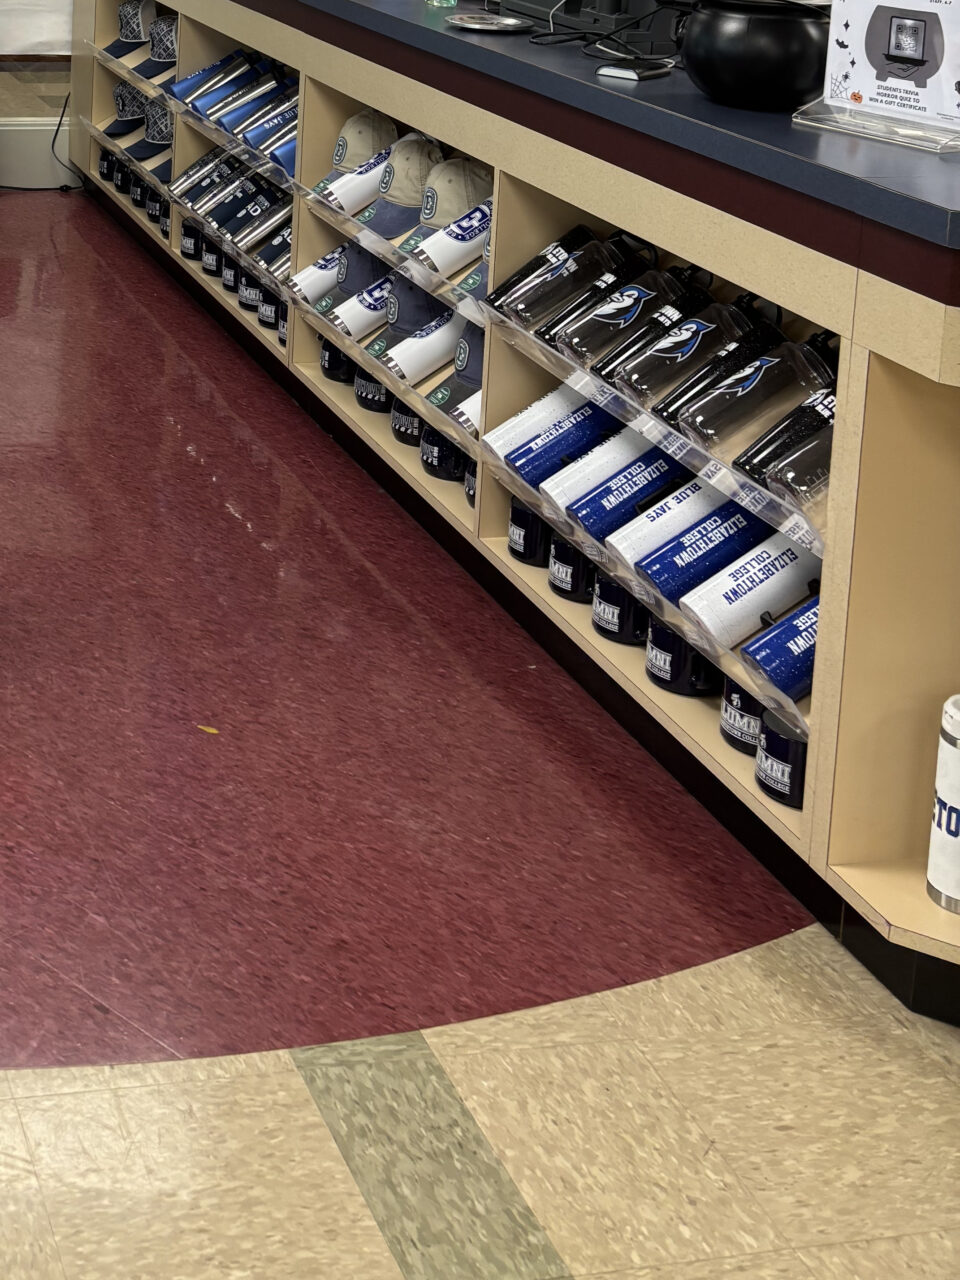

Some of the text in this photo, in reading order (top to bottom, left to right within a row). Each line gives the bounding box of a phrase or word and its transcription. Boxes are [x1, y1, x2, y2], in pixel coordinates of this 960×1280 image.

[876, 91, 898, 100] HORROR
[877, 84, 920, 97] STUDENTS TRIVIA
[896, 101, 927, 113] CERTIFICATE
[601, 459, 669, 511] ELIZABETHTOWN
[609, 461, 646, 490] COLLEGE
[645, 482, 702, 523] BLUE JAYS
[673, 514, 748, 568] ELIZABETHTOWN
[680, 515, 723, 547] COLLEGE
[722, 548, 799, 606] ELIZABETHTOWN
[728, 550, 772, 582] COLLEGE
[721, 703, 761, 734] LUMN
[756, 752, 791, 782] UMNI
